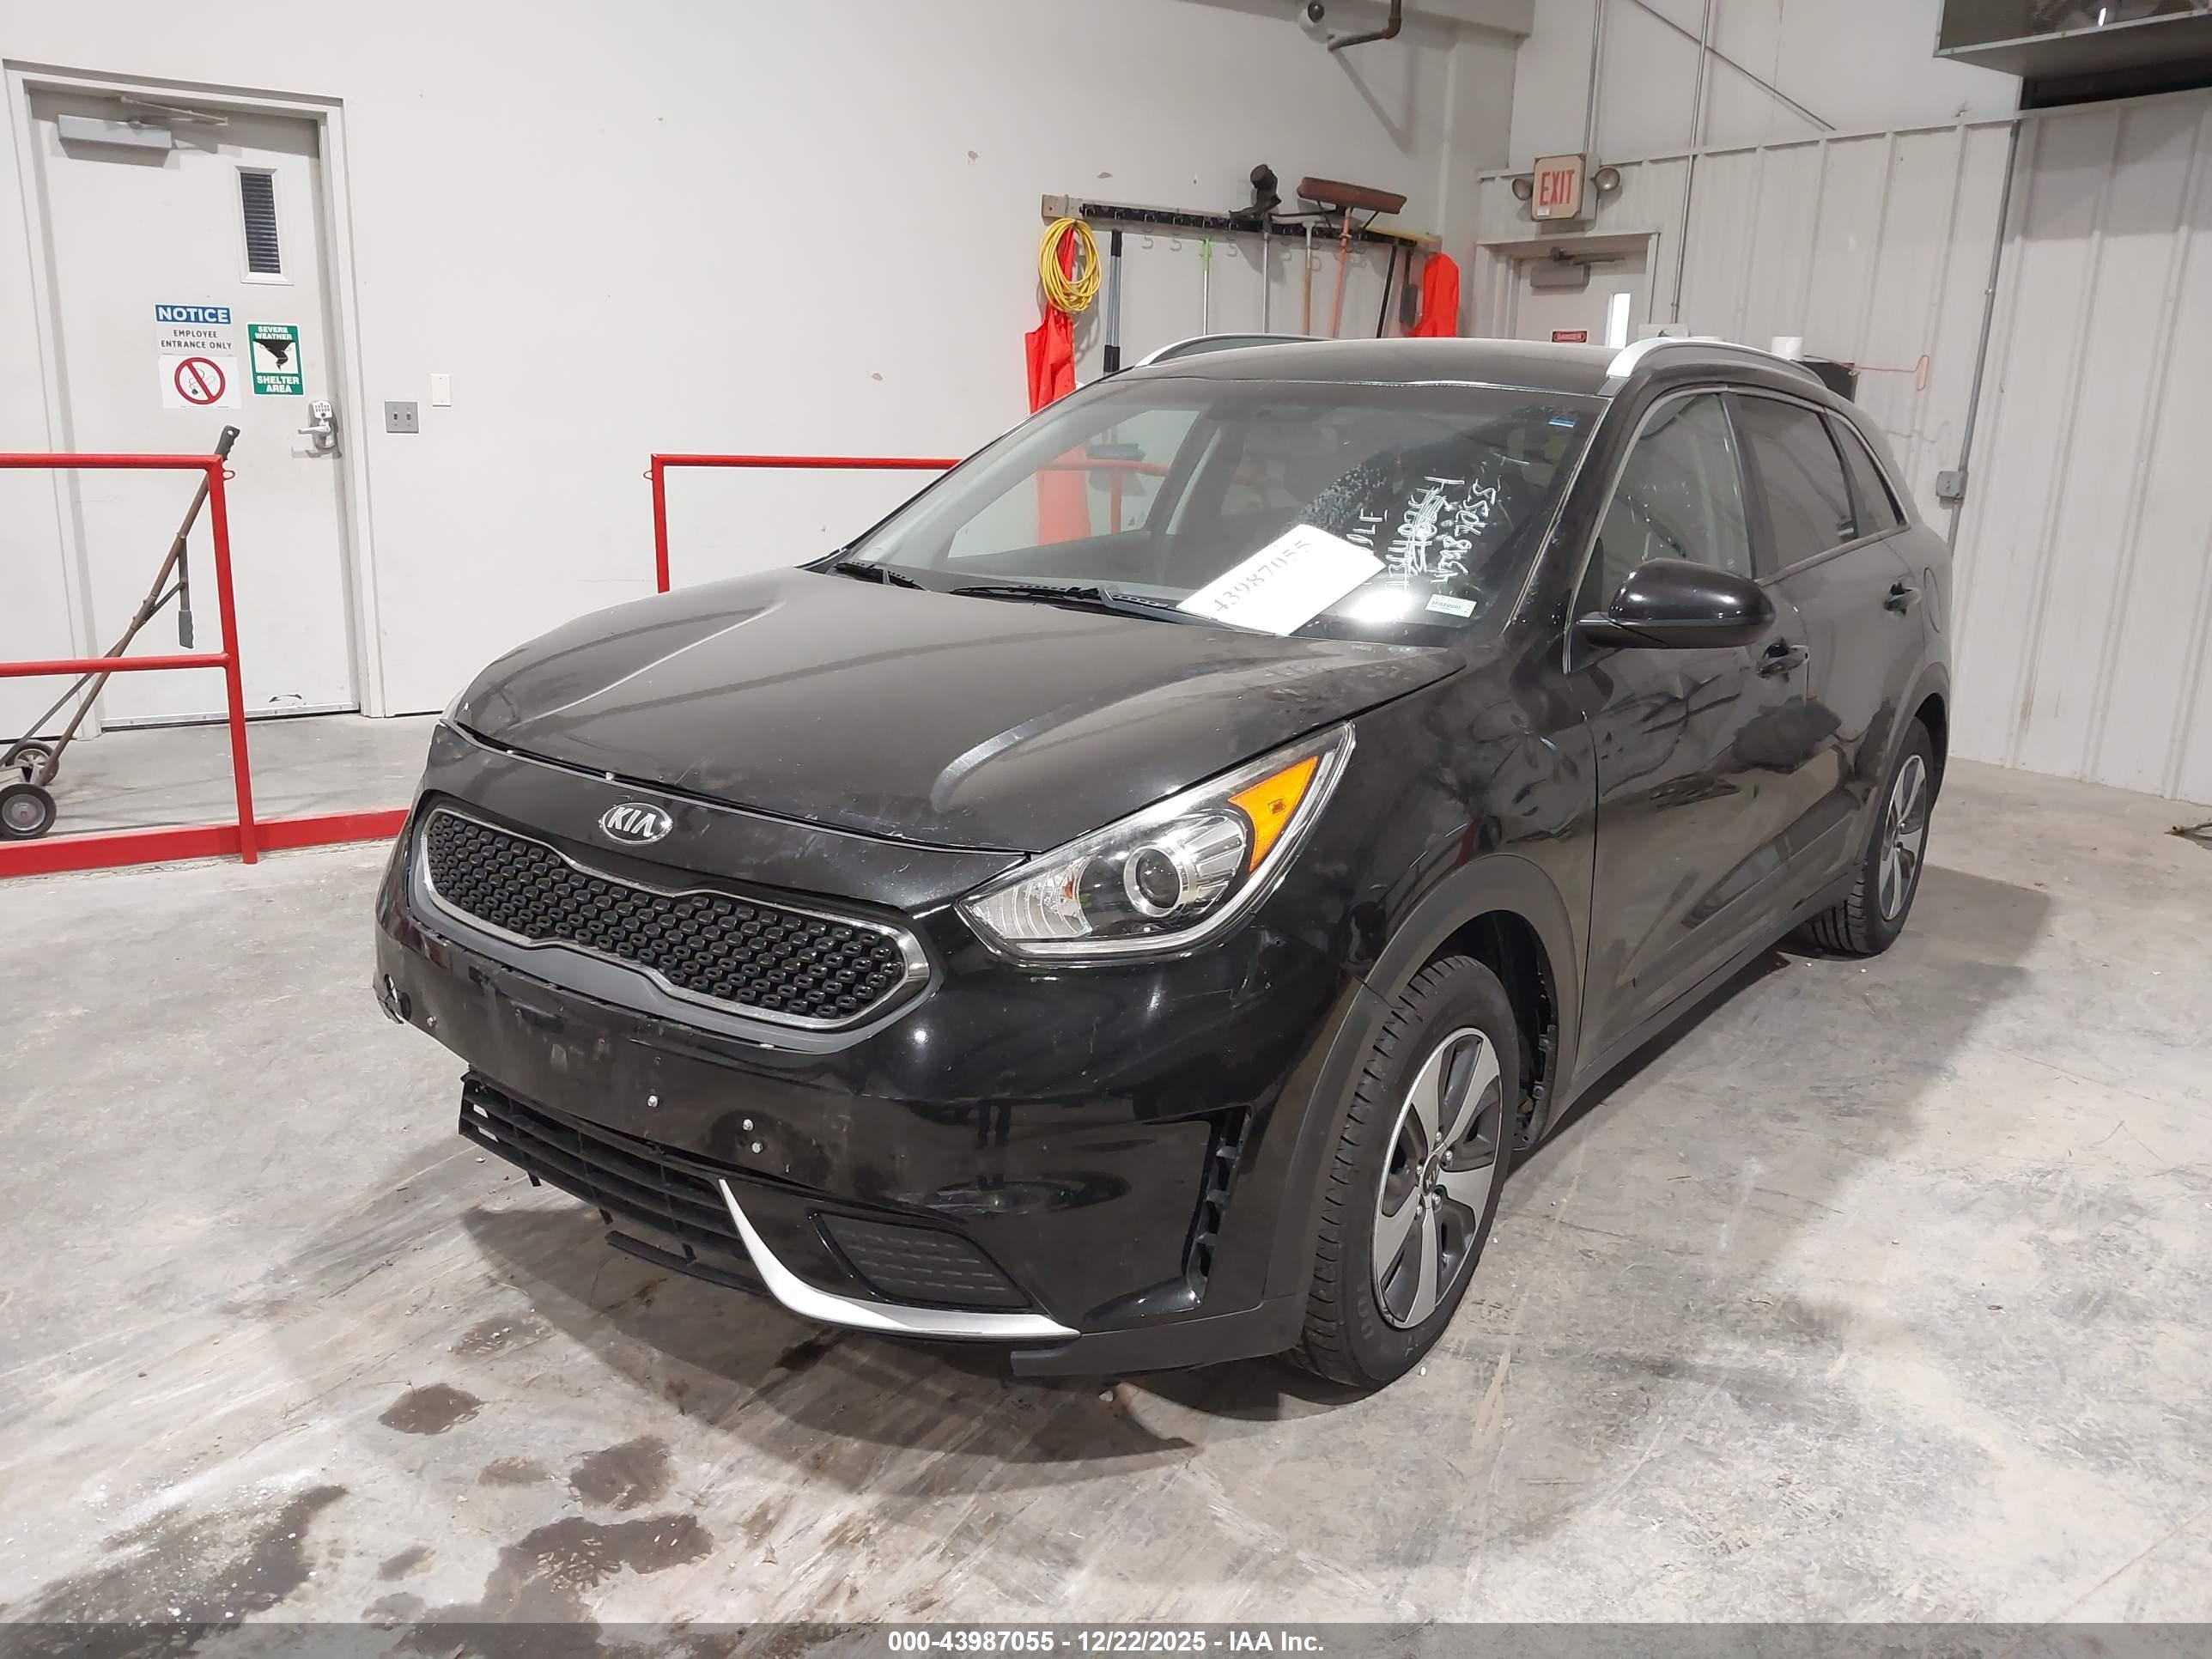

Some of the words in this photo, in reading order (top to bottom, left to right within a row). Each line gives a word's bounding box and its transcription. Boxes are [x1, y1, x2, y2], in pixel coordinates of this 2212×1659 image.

[1540, 169, 1575, 206] EXIT
[158, 307, 229, 323] NOTICE
[173, 330, 218, 338] EMPLOYEE
[161, 340, 207, 349] ENTRANCE
[257, 375, 300, 385] SHELTER
[266, 384, 293, 393] AREA
[606, 806, 657, 838] KIA
